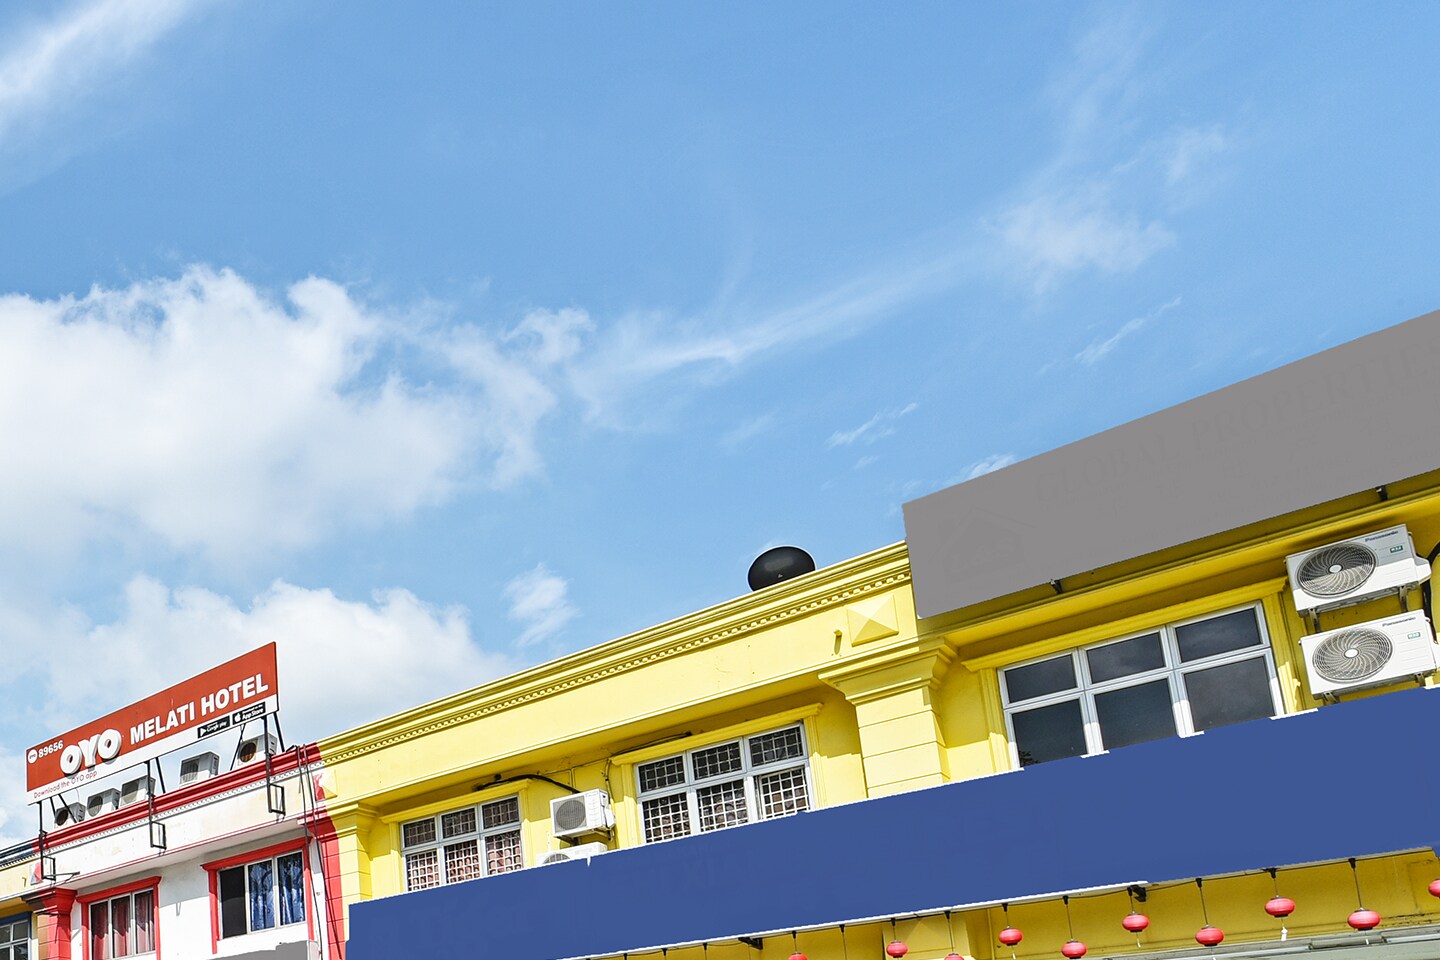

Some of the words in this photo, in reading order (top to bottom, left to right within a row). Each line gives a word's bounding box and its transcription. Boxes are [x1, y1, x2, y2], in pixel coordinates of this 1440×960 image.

[60, 728, 122, 775] OYO
[130, 702, 196, 745] MELATI
[201, 673, 269, 716] HOTEL
[38, 740, 64, 758] 89656
[33, 783, 60, 799] Download
[60, 780, 70, 789] the
[85, 770, 98, 781] app
